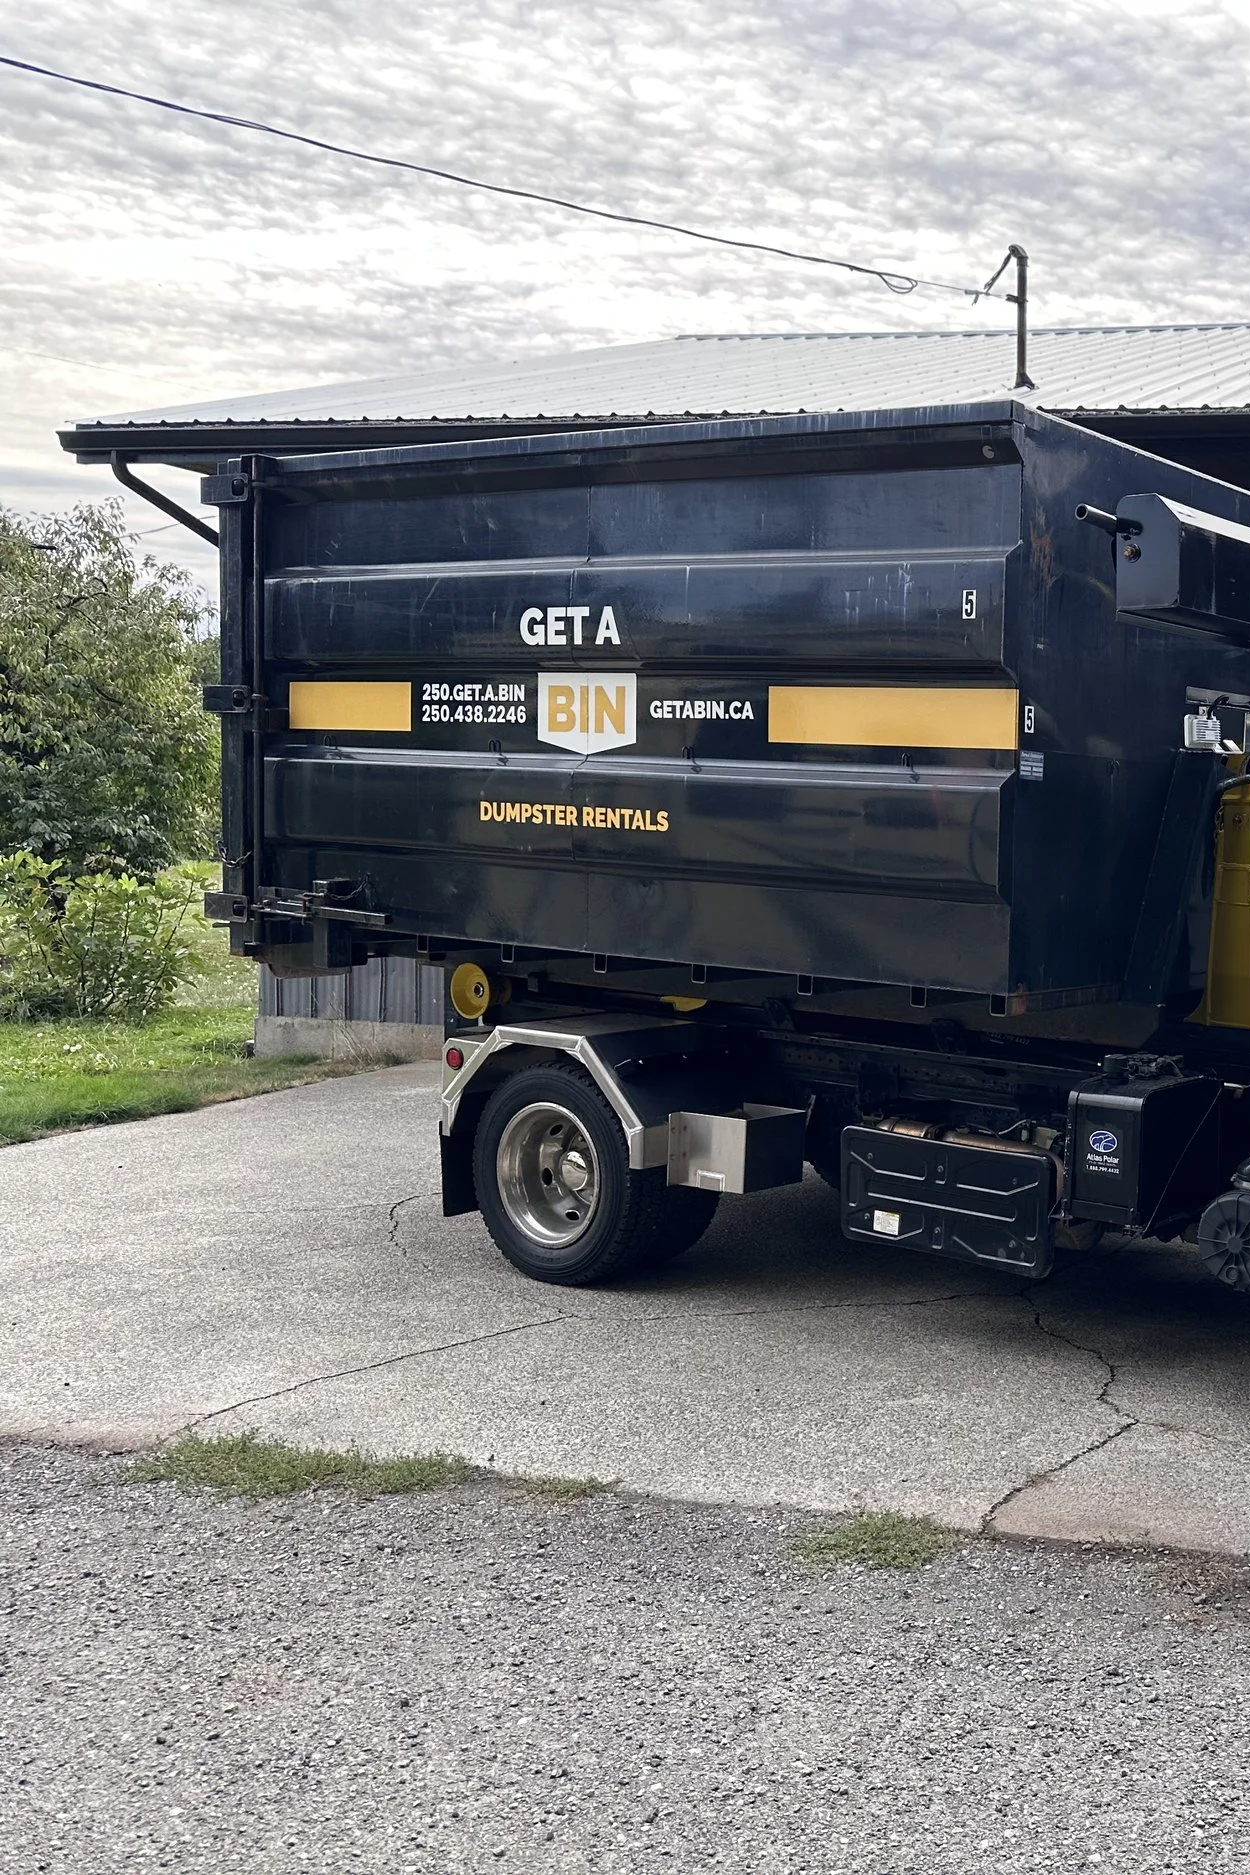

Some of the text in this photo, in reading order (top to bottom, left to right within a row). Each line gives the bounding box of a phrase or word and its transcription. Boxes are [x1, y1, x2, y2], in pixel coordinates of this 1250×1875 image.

[964, 590, 974, 618] 5
[519, 605, 622, 646] GET A
[421, 683, 526, 702] 250.GET.A.BIN
[421, 704, 527, 724] 250.438.2246
[548, 686, 626, 733] BIN
[649, 700, 755, 720] GETABIN.CA
[1026, 707, 1033, 731] 5
[479, 800, 669, 832] DUMPSTER RENTALS
[1086, 1153, 1120, 1164] Atlas Polar
